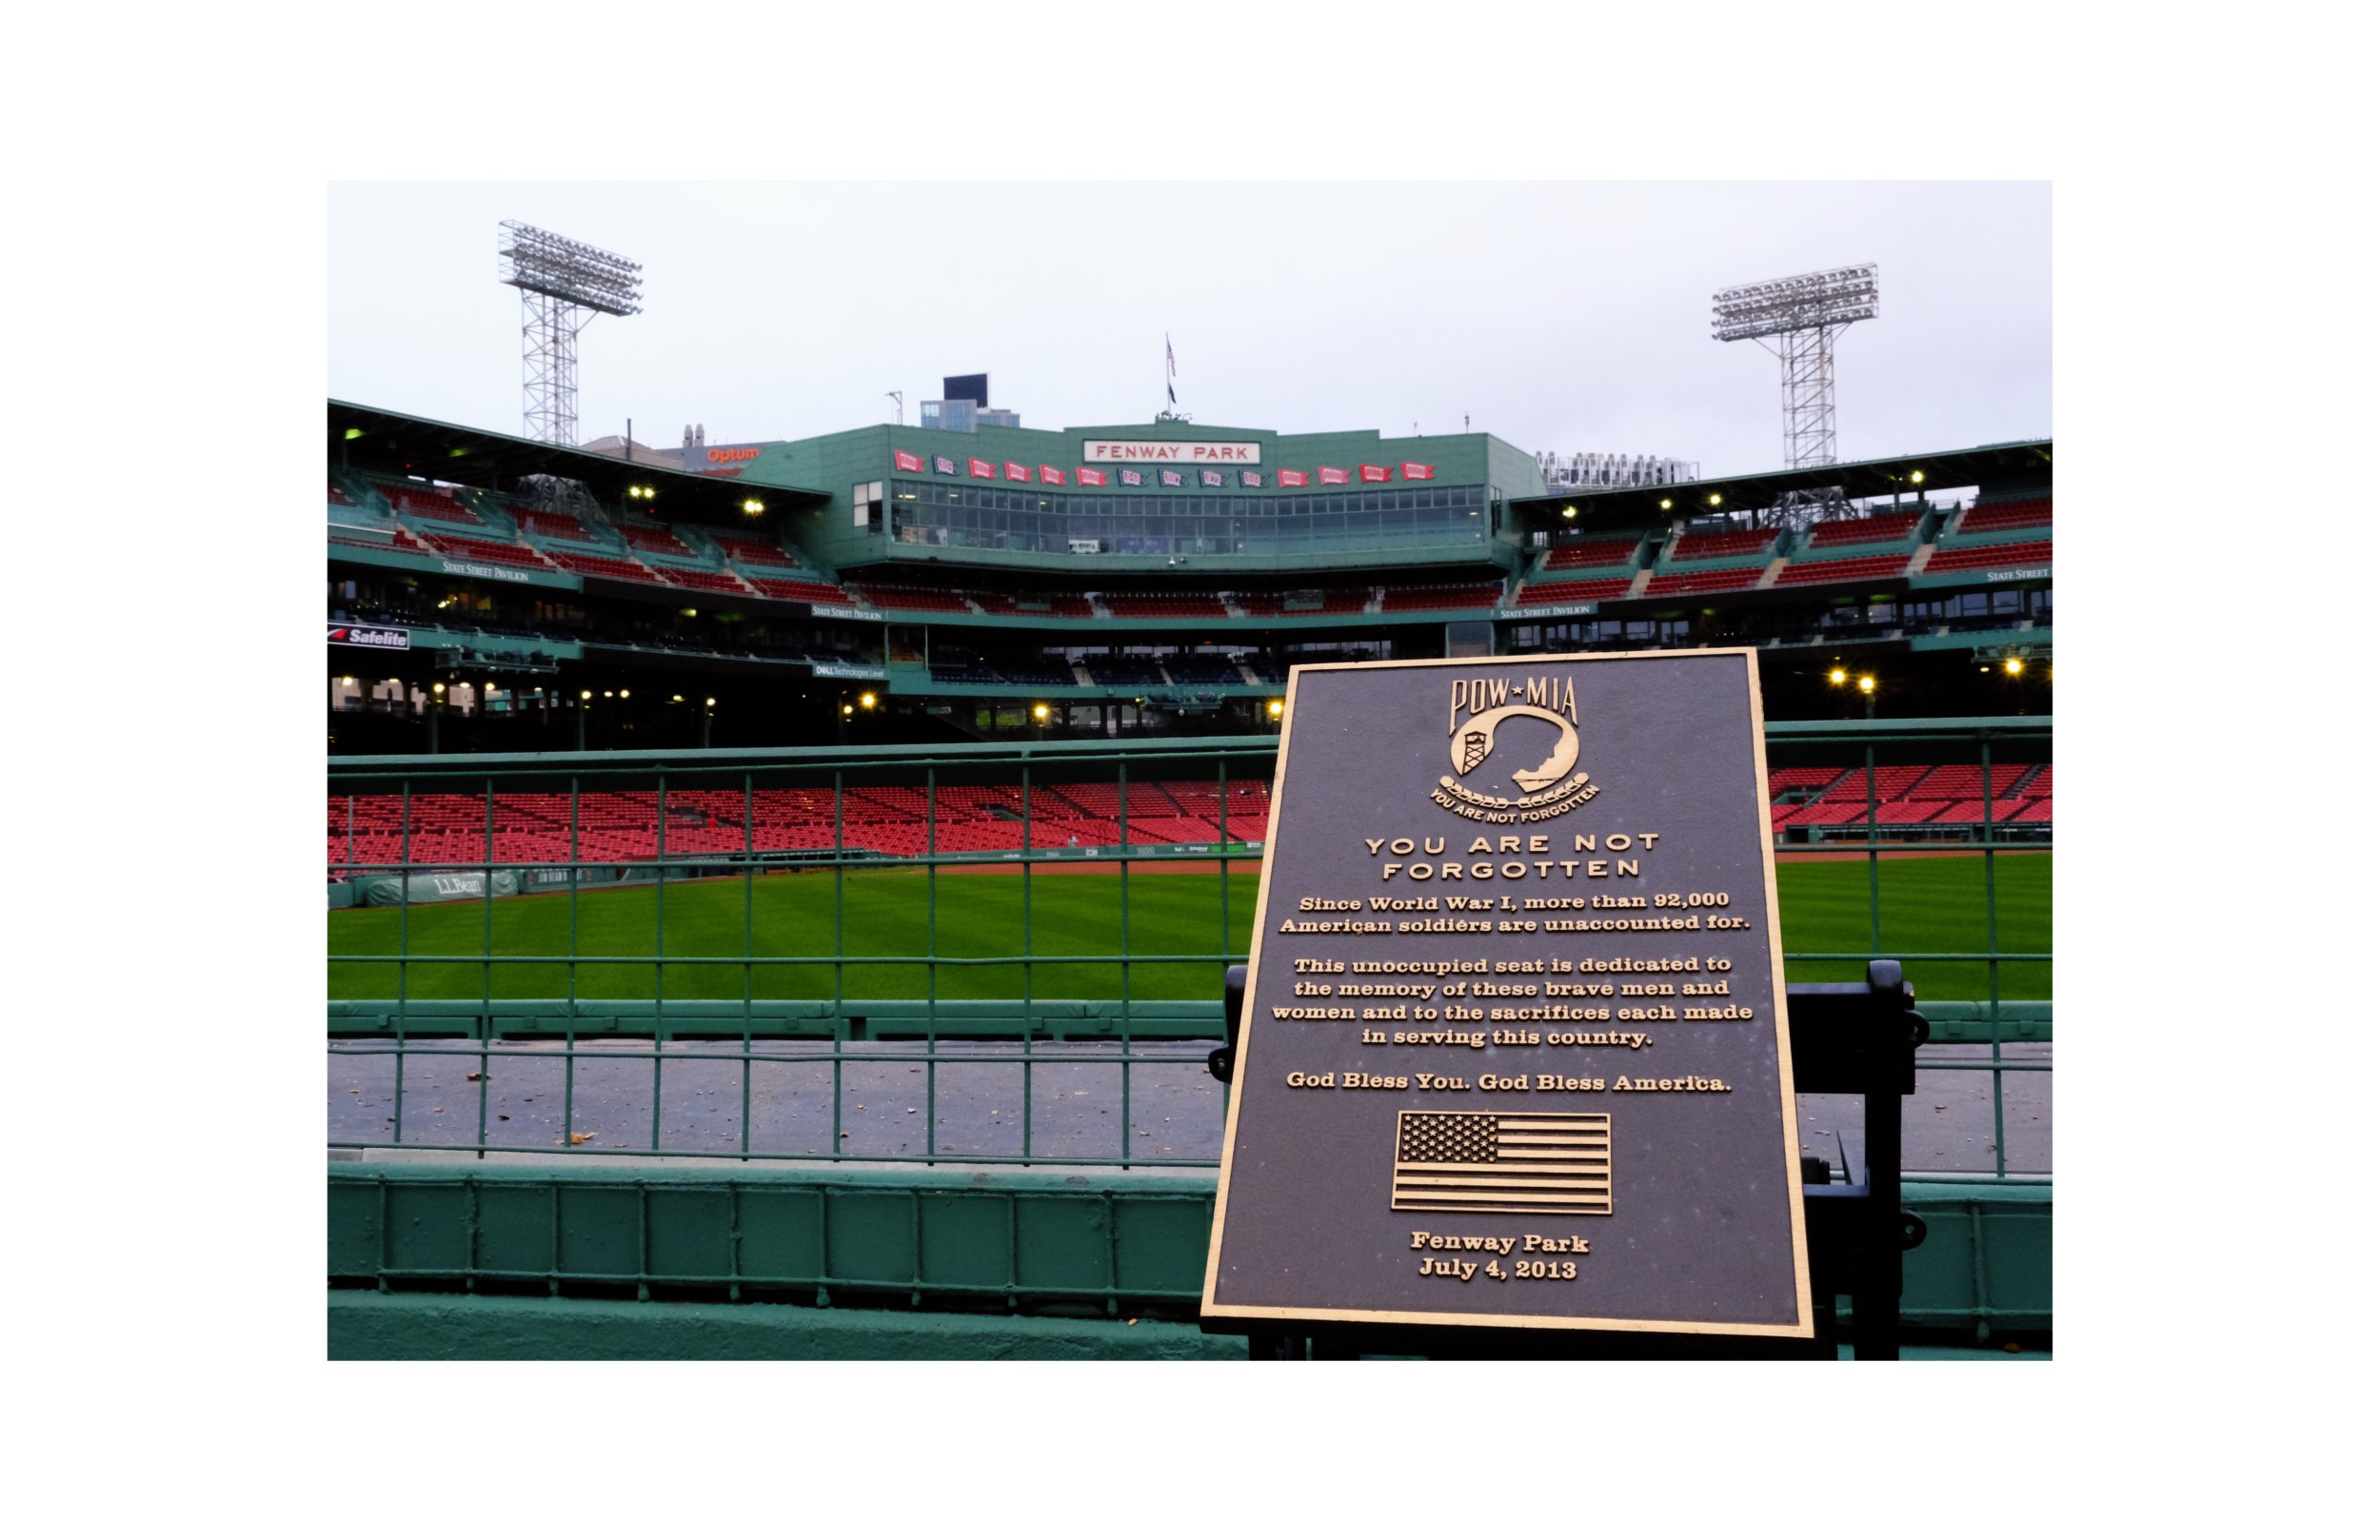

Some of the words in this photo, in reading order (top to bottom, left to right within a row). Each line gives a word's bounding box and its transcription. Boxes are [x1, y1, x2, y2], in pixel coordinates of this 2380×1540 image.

[707, 448, 760, 464] Optum
[1097, 445, 1180, 459] FENWAY
[1194, 446, 1248, 460] PARK
[443, 561, 466, 574] STATE
[466, 564, 493, 578] STREET
[495, 567, 529, 582] PAVILION
[1987, 571, 2015, 582] STATE
[2015, 569, 2050, 580] STREET
[1500, 609, 1523, 619] STATE
[1523, 608, 1551, 617] STREET
[1553, 605, 1590, 616] PAVILION
[349, 628, 407, 646] Safelite
[1449, 678, 1510, 737] POW
[1526, 676, 1578, 727] MIA
[1430, 788, 1456, 809] YOU
[1454, 804, 1484, 822] ARE
[1486, 811, 1517, 824] NOT
[1520, 784, 1600, 824] FORGOTTEN
[1367, 837, 1445, 856] YOU
[1469, 835, 1548, 854] ARE
[1575, 833, 1658, 852] NOT
[1383, 859, 1638, 880] FORGOTTEN
[1300, 898, 1361, 912] Since
[1369, 897, 1438, 912] World
[1446, 897, 1493, 911] War
[1502, 896, 1516, 912] I,
[1525, 898, 1585, 910] more
[1592, 895, 1646, 909] than
[1655, 893, 1729, 910] 92,000
[1279, 918, 1391, 935] American
[1398, 918, 1492, 933] soldiers
[1498, 920, 1537, 933] are
[1545, 916, 1699, 932] unaccounted
[1707, 915, 1749, 930] for.
[1295, 958, 1345, 974] This
[1353, 958, 1488, 977] unoccupied
[1496, 959, 1544, 974] seat
[1553, 958, 1573, 973] is
[1579, 957, 1699, 973] dedicated
[1707, 958, 1731, 972] to
[1295, 981, 1332, 997] the
[1339, 984, 1436, 1000] memory
[1442, 981, 1467, 997] of
[1473, 981, 1537, 997] these
[1545, 981, 1615, 997] brave
[1622, 983, 1676, 997] men
[1682, 979, 1729, 996] and
[1273, 1007, 1357, 1020] women
[1362, 1004, 1406, 1020] and
[1414, 1005, 1438, 1020] to
[1445, 1005, 1484, 1021] the
[1490, 1005, 1610, 1021] sacrifices
[1617, 1005, 1676, 1020] each
[1684, 1004, 1753, 1020] made
[1362, 1029, 1386, 1044] in
[1394, 1029, 1485, 1049] serving
[1493, 1029, 1540, 1045] this
[1547, 1031, 1653, 1049] country.
[1286, 1071, 1335, 1088] God
[1343, 1072, 1408, 1090] Bless
[1416, 1073, 1471, 1091] You.
[1478, 1074, 1529, 1091] God
[1537, 1075, 1605, 1092] Bless
[1614, 1076, 1732, 1093] America.
[1412, 1231, 1516, 1255] Fenway
[1523, 1234, 1589, 1254] Park
[1419, 1256, 1478, 1281] July
[1486, 1259, 1507, 1281] 4,
[1516, 1260, 1577, 1280] 2013
